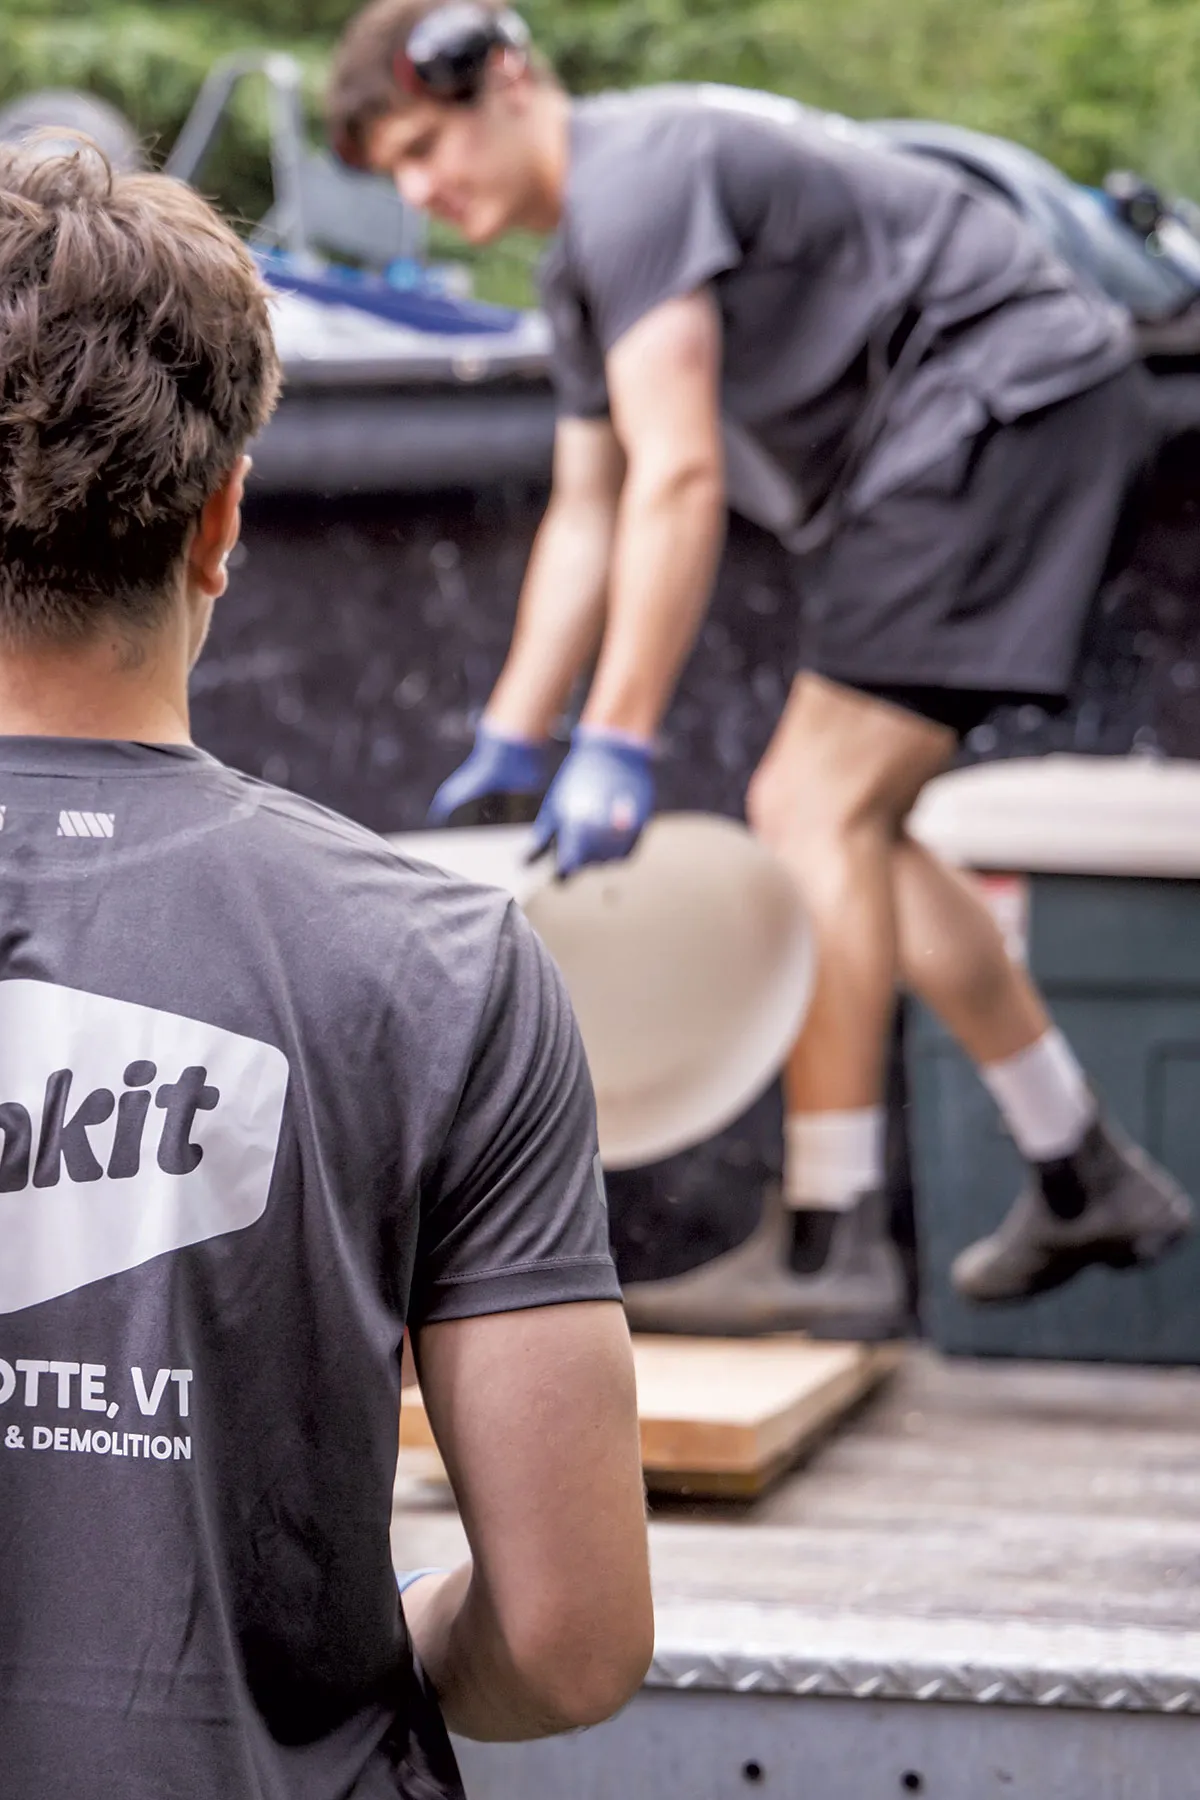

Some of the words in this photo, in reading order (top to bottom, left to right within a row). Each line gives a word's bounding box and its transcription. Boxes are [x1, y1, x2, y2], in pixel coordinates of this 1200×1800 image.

[130, 1366, 194, 1417] VT
[4, 1425, 25, 1449] &
[32, 1427, 192, 1460] DEMOLITION
